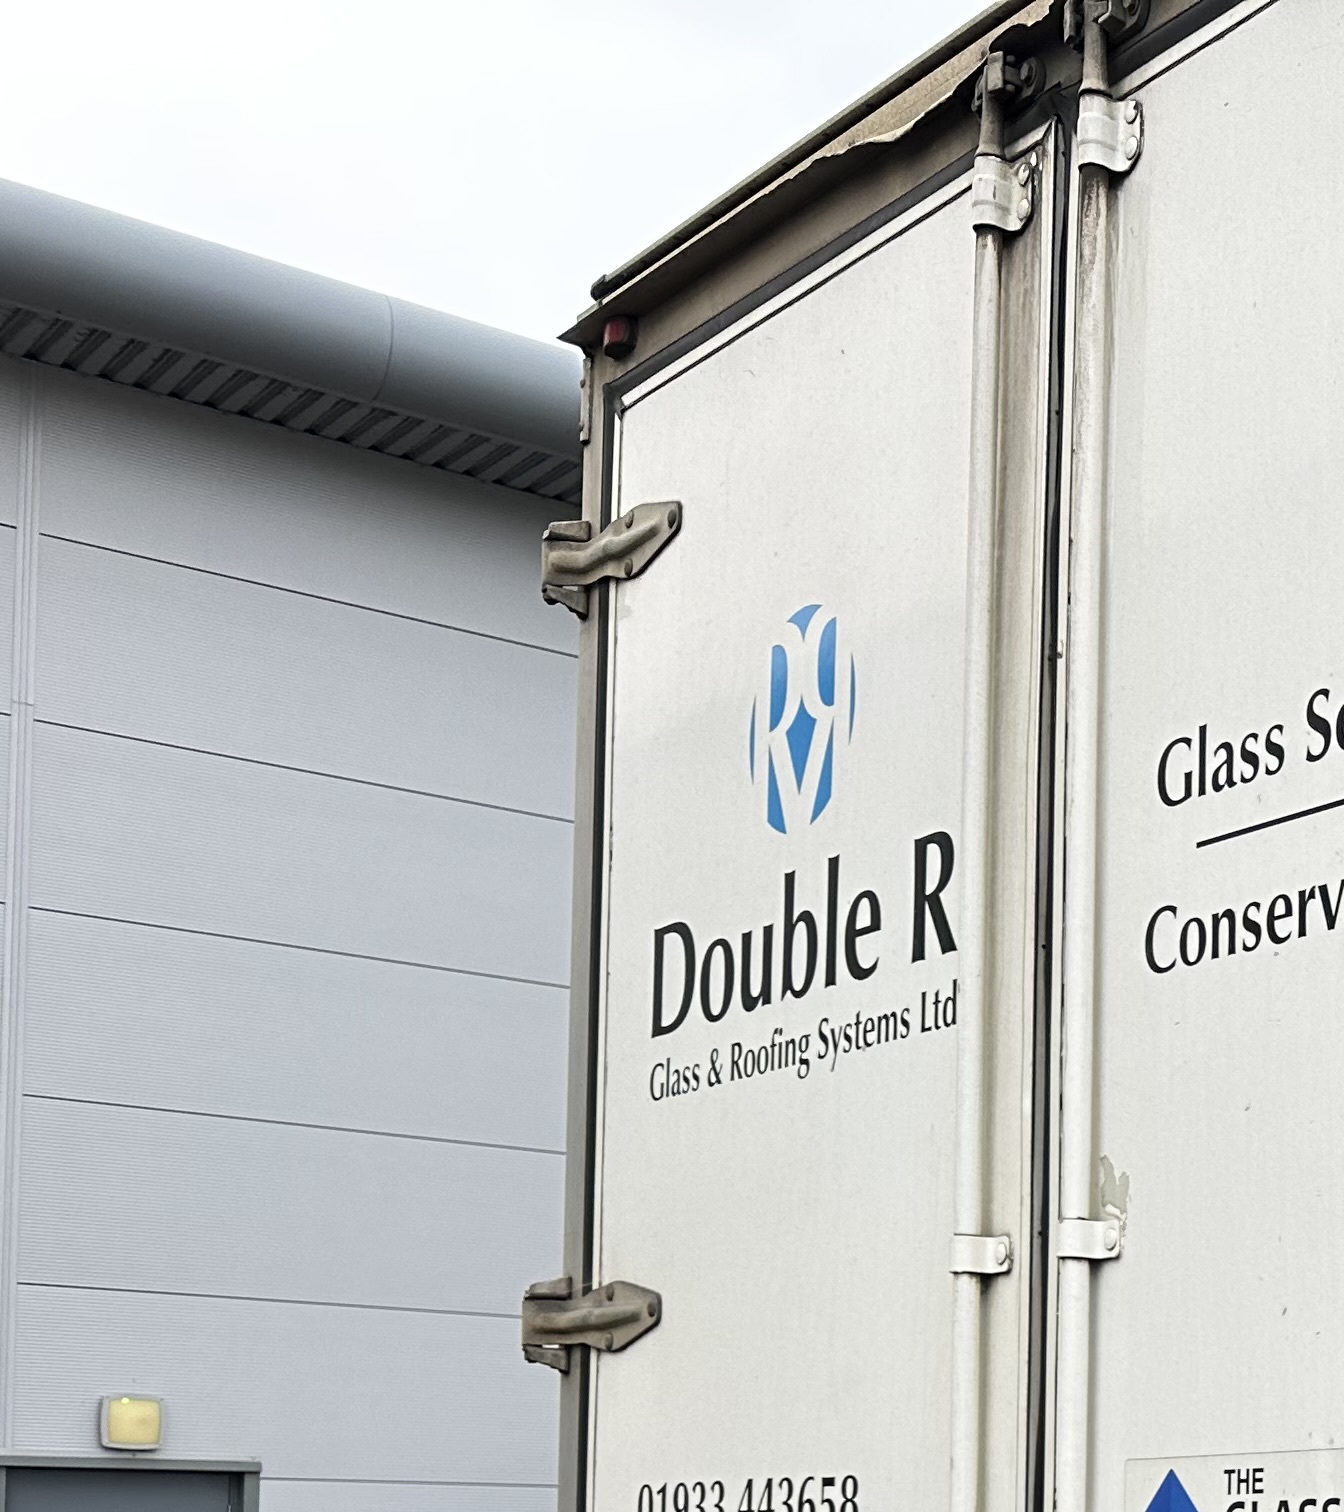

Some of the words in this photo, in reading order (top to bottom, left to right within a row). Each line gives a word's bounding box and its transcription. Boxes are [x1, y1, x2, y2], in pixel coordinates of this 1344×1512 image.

[1156, 723, 1285, 807] Glass
[651, 854, 881, 1038] Double
[911, 831, 958, 964] R
[649, 1057, 701, 1101] Glass
[706, 1048, 723, 1087] &
[730, 1028, 811, 1079] Roofing
[817, 1001, 910, 1072] Systems
[920, 979, 958, 1033] Ltd
[1224, 1467, 1265, 1495] THE
